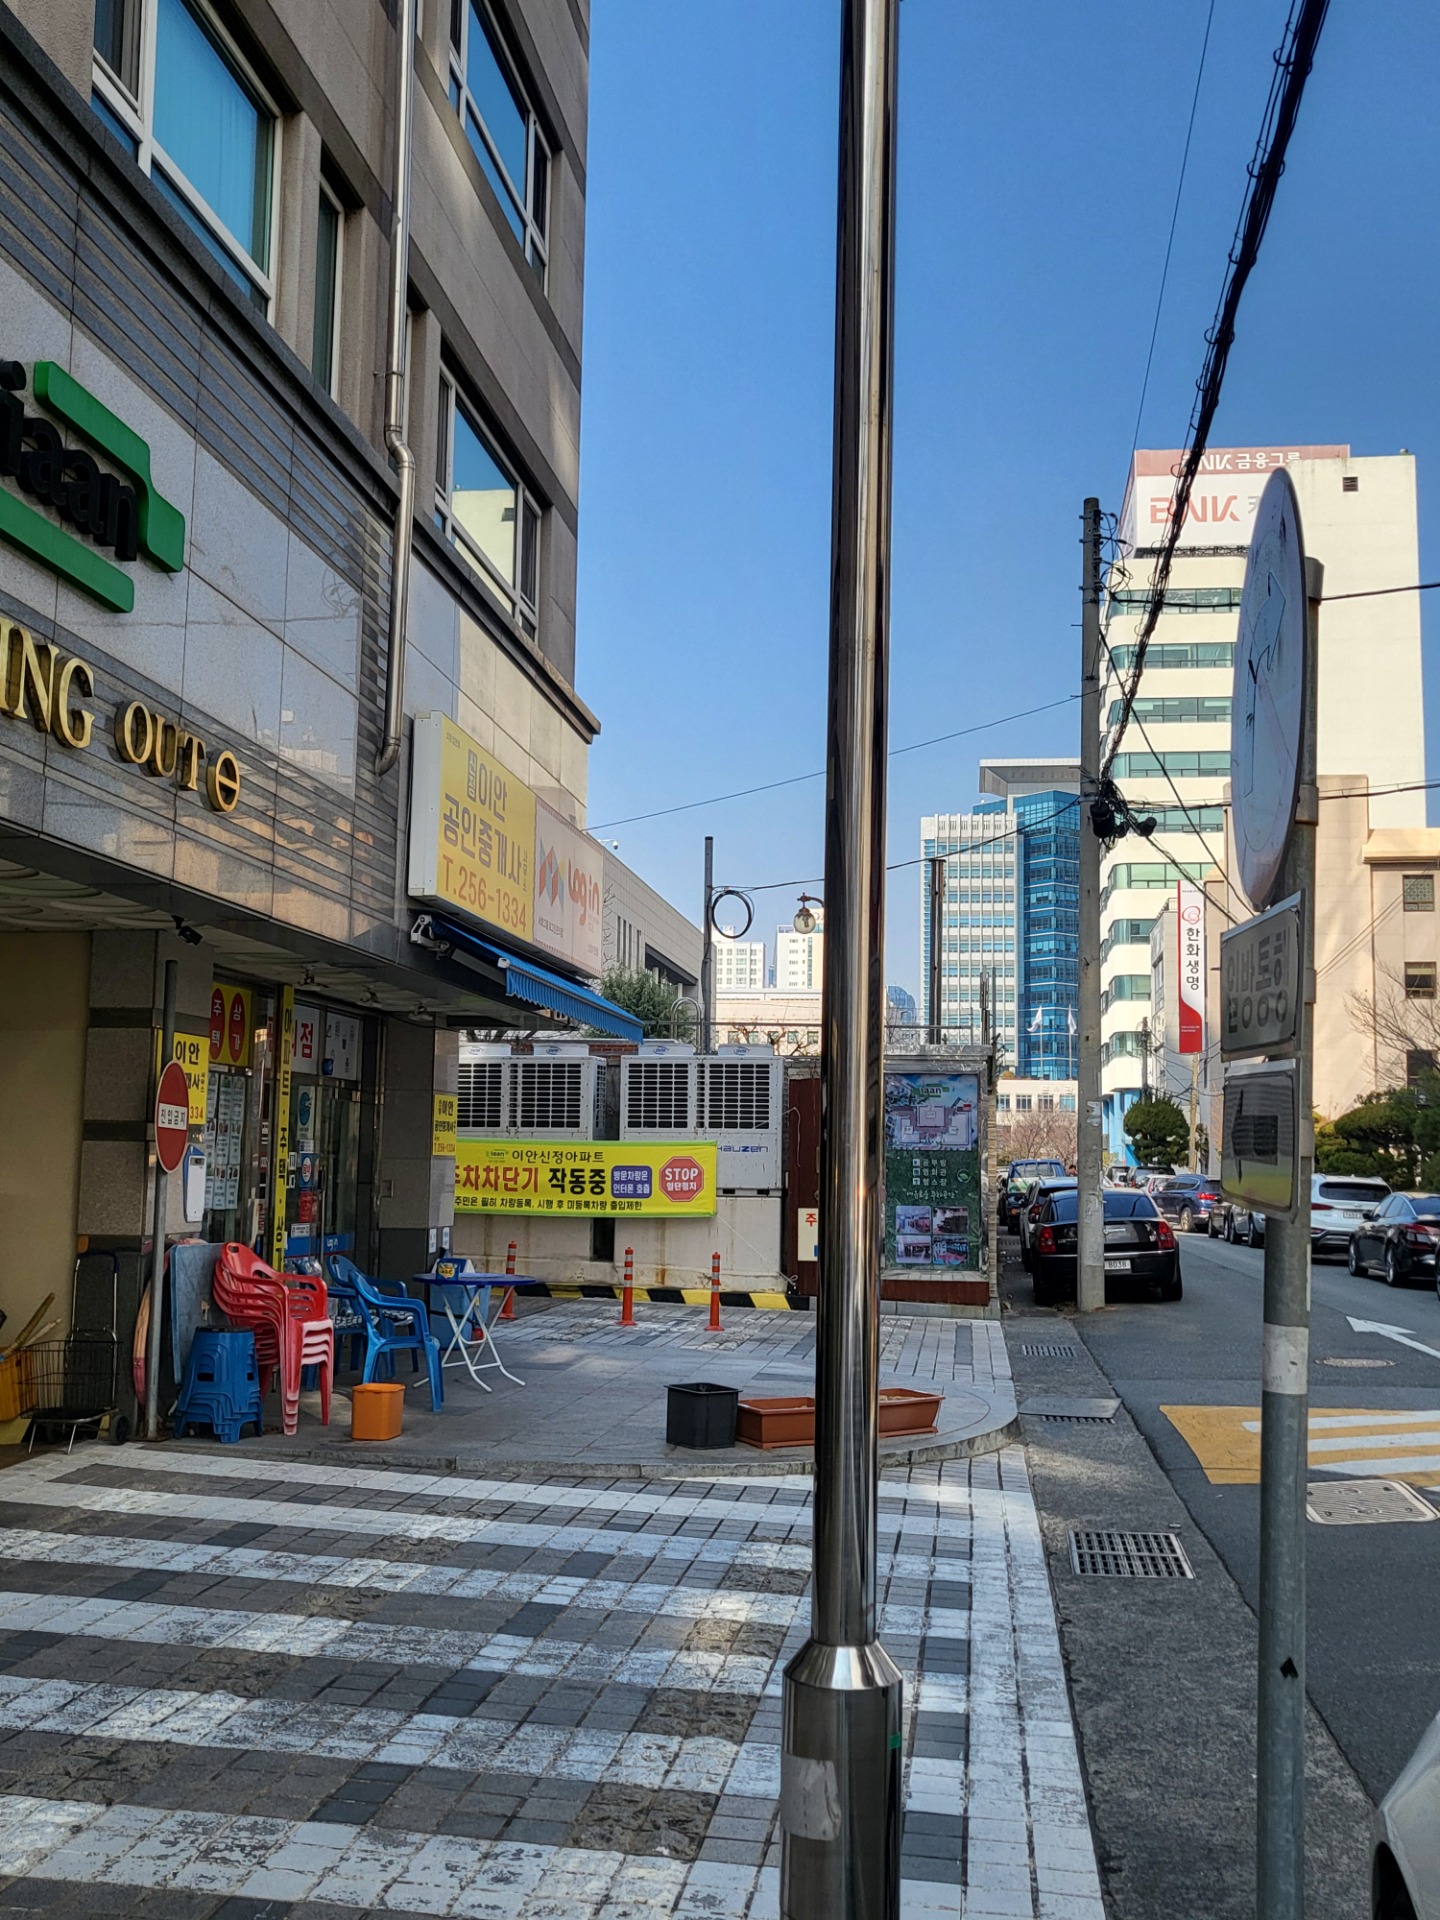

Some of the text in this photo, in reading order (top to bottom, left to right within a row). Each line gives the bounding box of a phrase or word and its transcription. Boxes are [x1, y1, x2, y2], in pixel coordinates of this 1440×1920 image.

[1150, 495, 1240, 523] BNK
[117, 701, 206, 791] OUT
[479, 763, 507, 823] 이안
[443, 793, 521, 885] 공인중개사
[443, 854, 527, 933] T.256-1334
[1186, 927, 1201, 991] 한화생명
[212, 999, 221, 1048] 주택
[232, 1003, 242, 1050] 상가
[175, 1041, 200, 1066] 이안
[161, 1109, 186, 1126] 진입금지
[511, 1150, 605, 1165] 이안신정아파트
[455, 1165, 606, 1195] 차차단기 작동중
[613, 1171, 648, 1181] 방문차량은
[665, 1168, 699, 1181] STOP
[666, 1182, 697, 1191] 일단정지
[613, 1184, 650, 1194] 인터폰 호출
[481, 1197, 497, 1207] 필히
[537, 1199, 554, 1209] 시행
[556, 1200, 565, 1209] 후
[567, 1200, 607, 1210] 미등록차량
[610, 1200, 643, 1211] 출입제한
